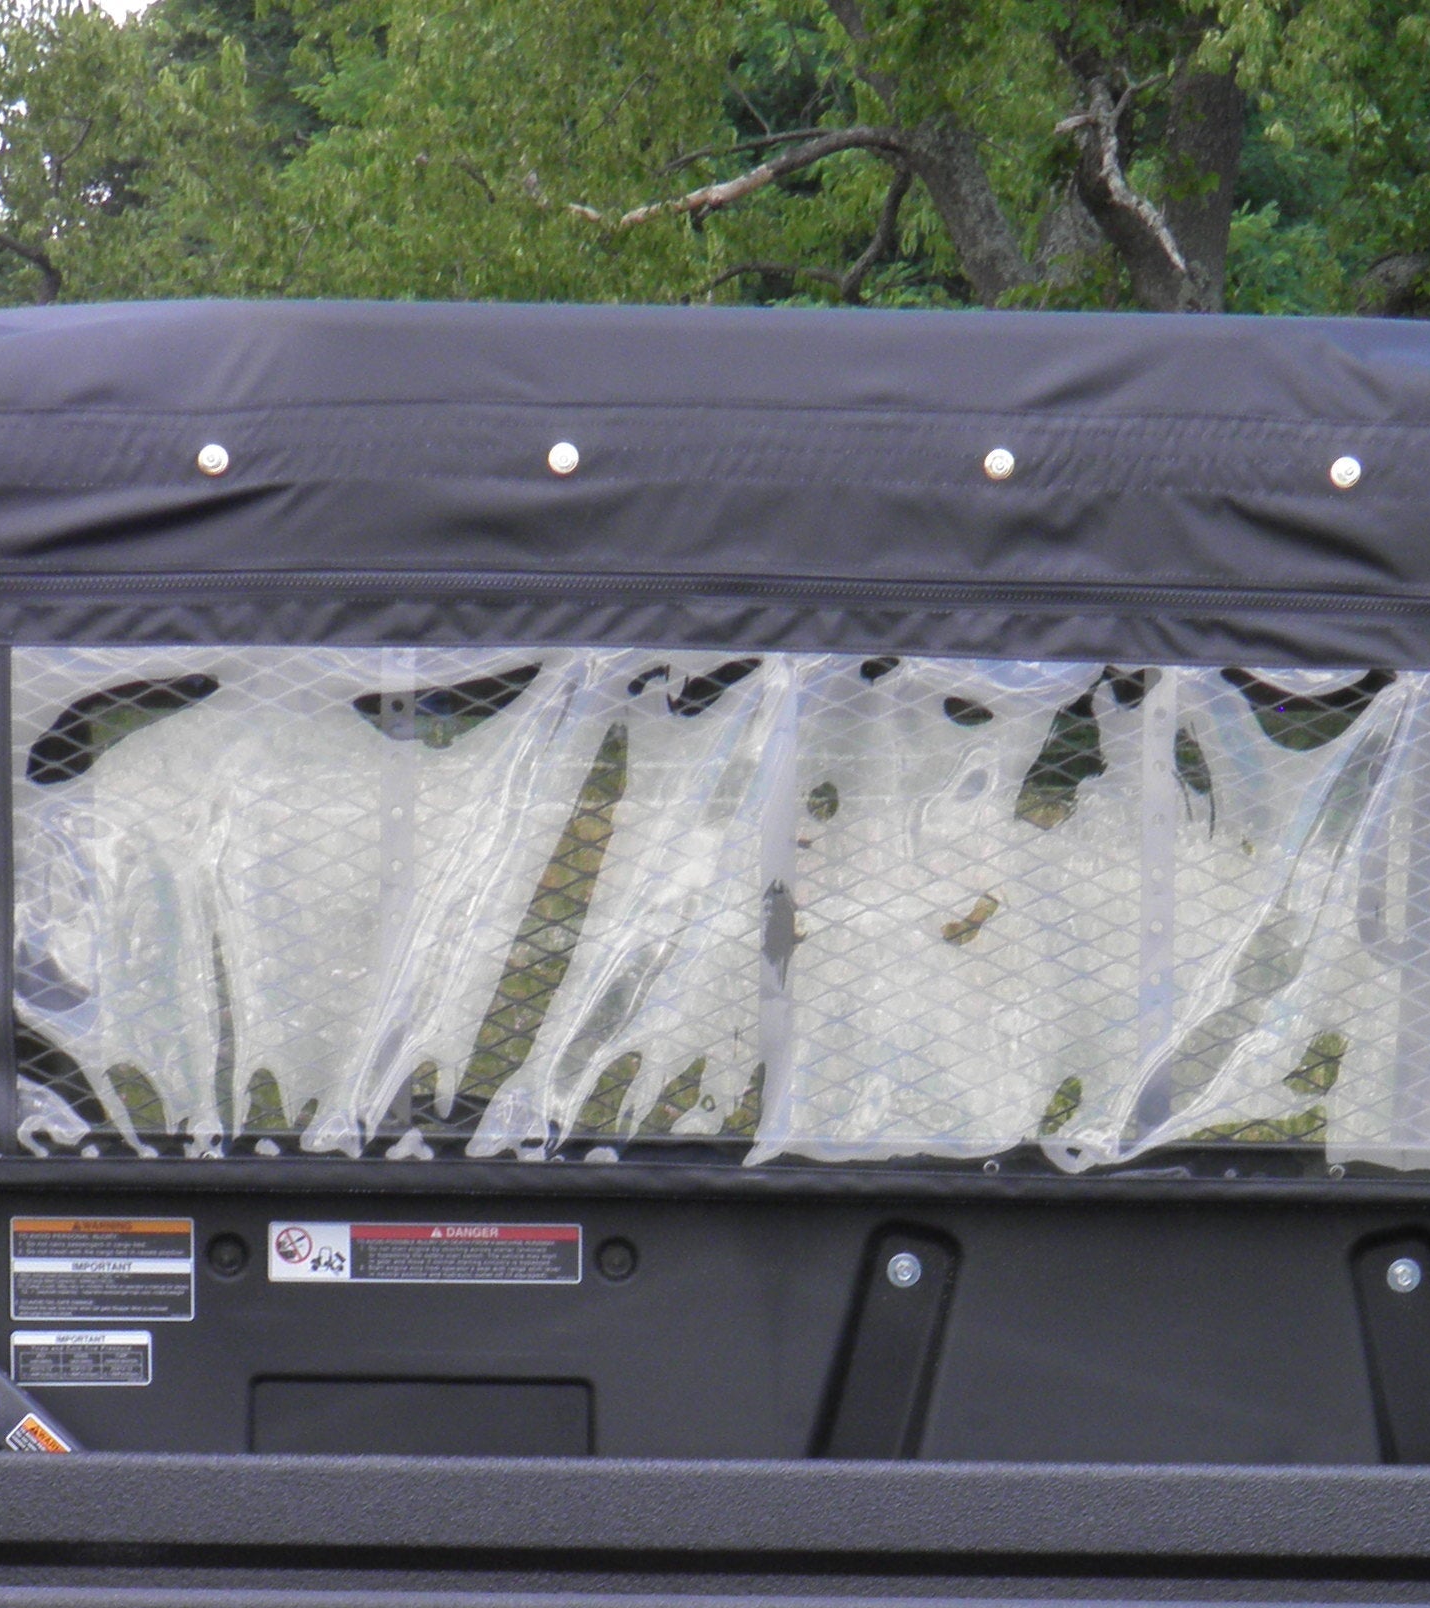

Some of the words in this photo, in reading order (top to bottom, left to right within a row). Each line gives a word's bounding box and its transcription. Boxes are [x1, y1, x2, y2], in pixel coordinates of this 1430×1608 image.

[446, 1226, 500, 1238] DANGER
[72, 1262, 134, 1272] IMPORTANT
[55, 1335, 107, 1343] IMPORTANT
